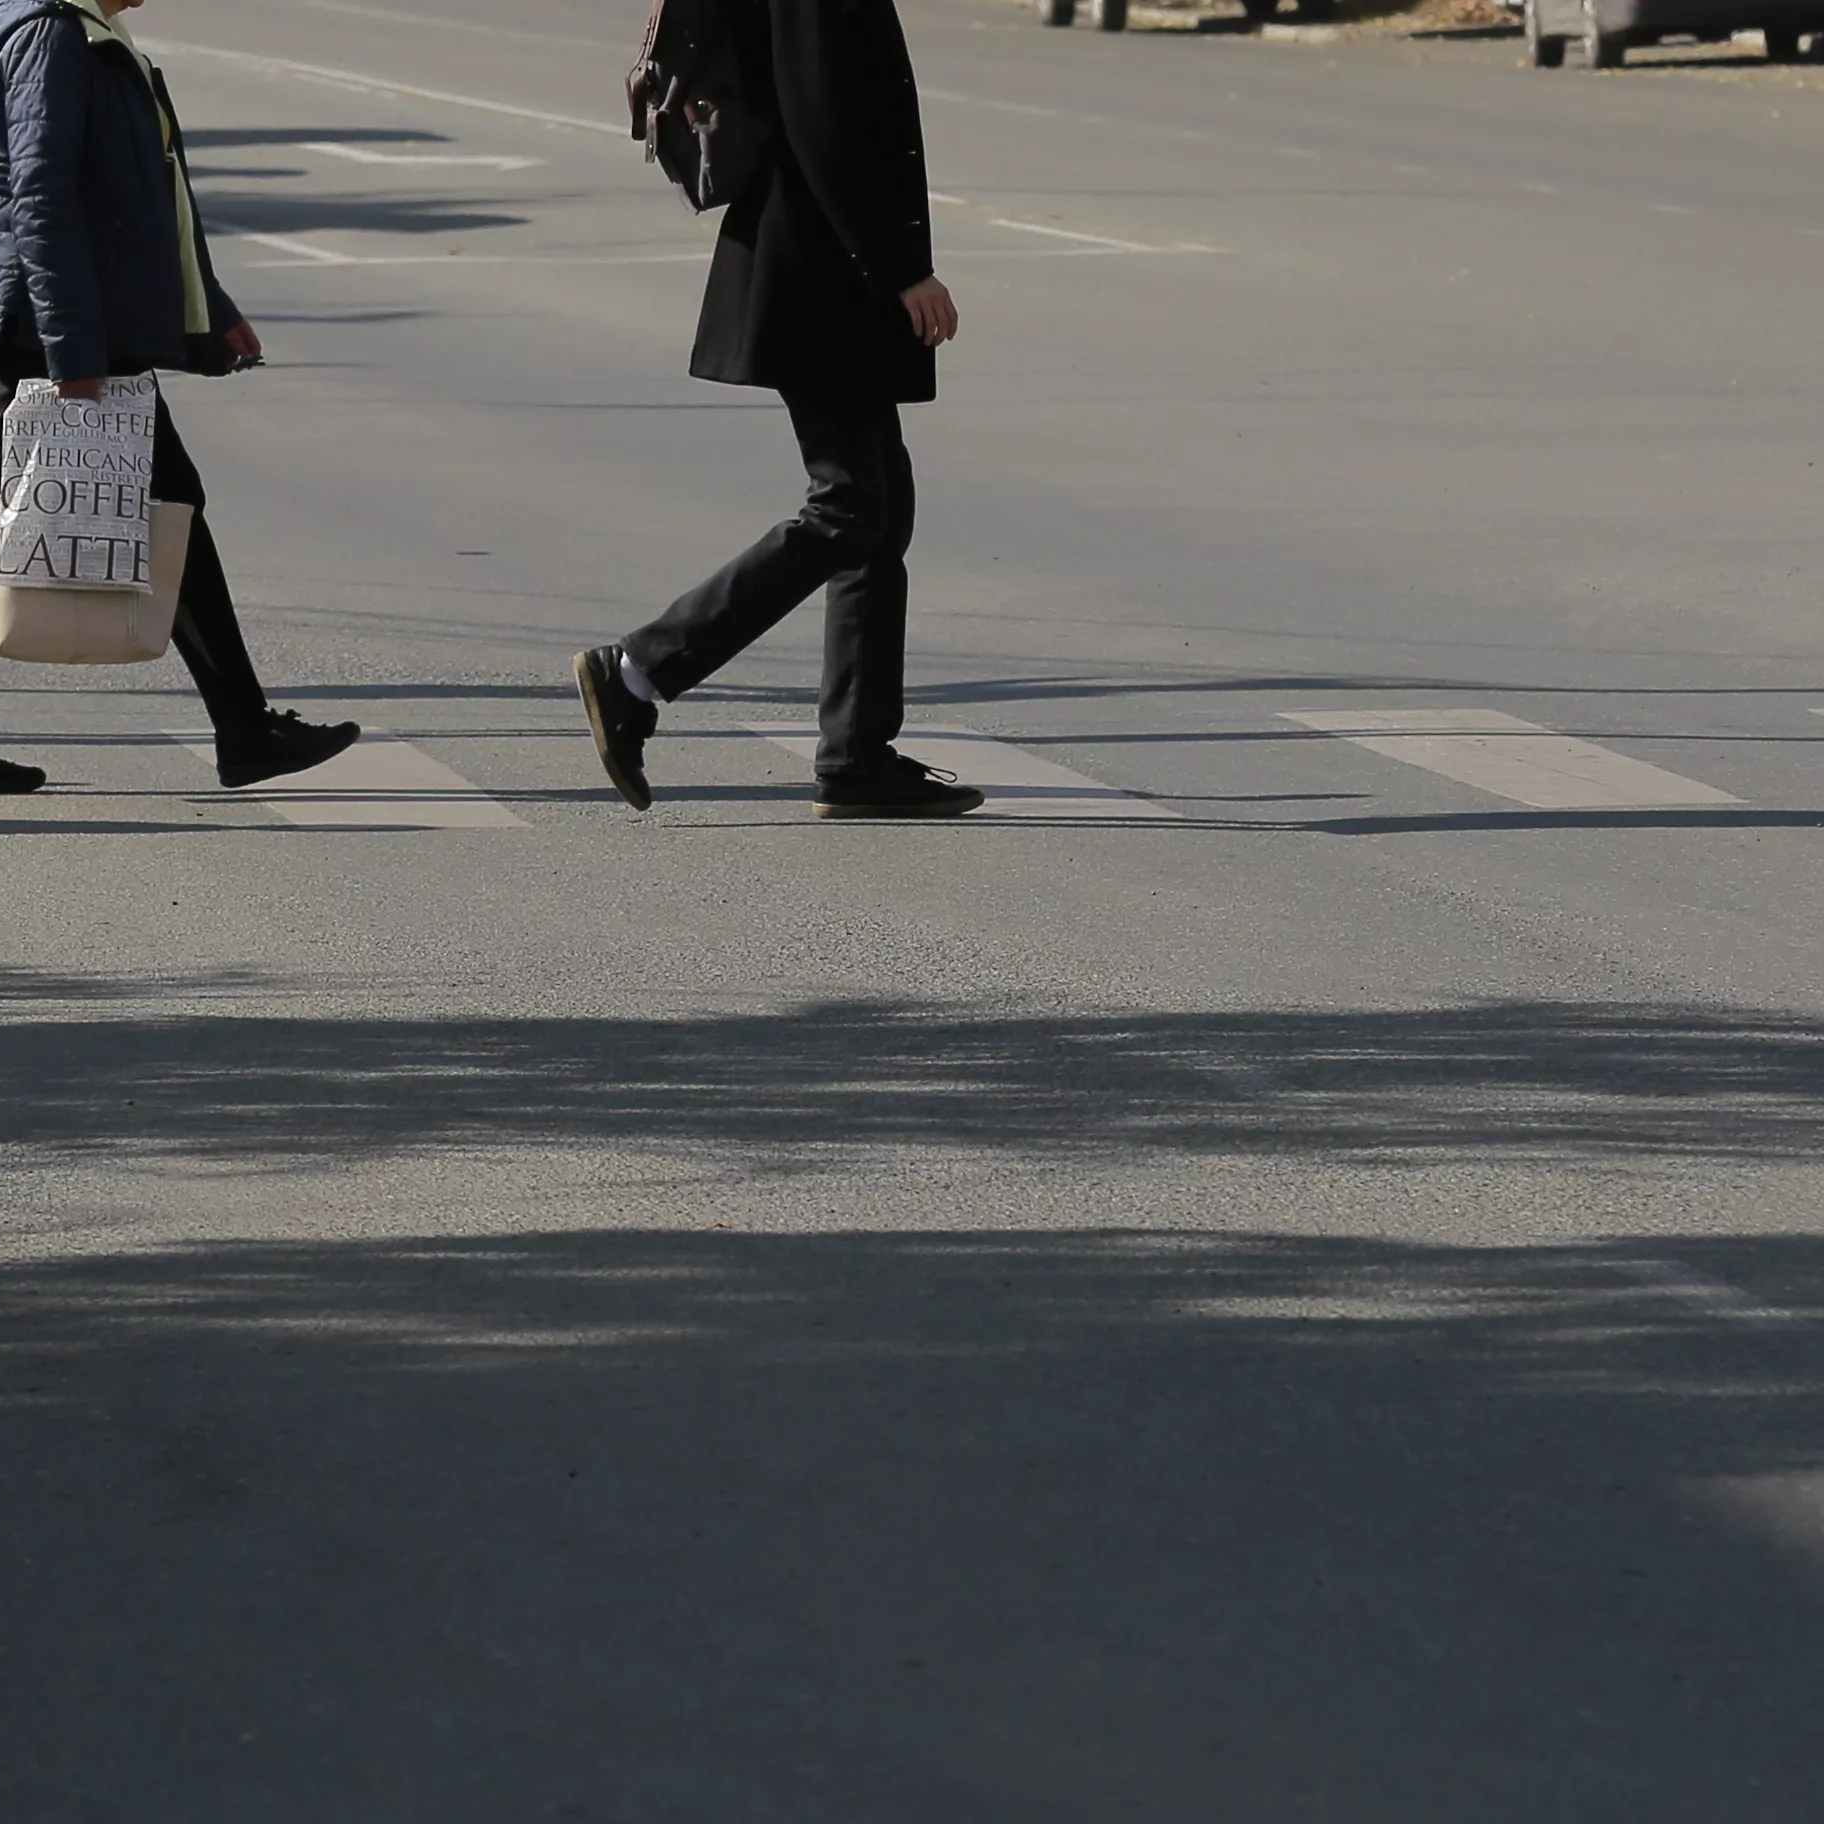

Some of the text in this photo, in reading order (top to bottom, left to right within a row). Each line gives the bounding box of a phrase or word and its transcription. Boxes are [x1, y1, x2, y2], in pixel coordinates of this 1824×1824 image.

[4, 417, 61, 437] BREVE
[61, 403, 155, 438] COFFEE
[3, 444, 153, 475] AMERICANO
[1, 474, 150, 522] COFFEE
